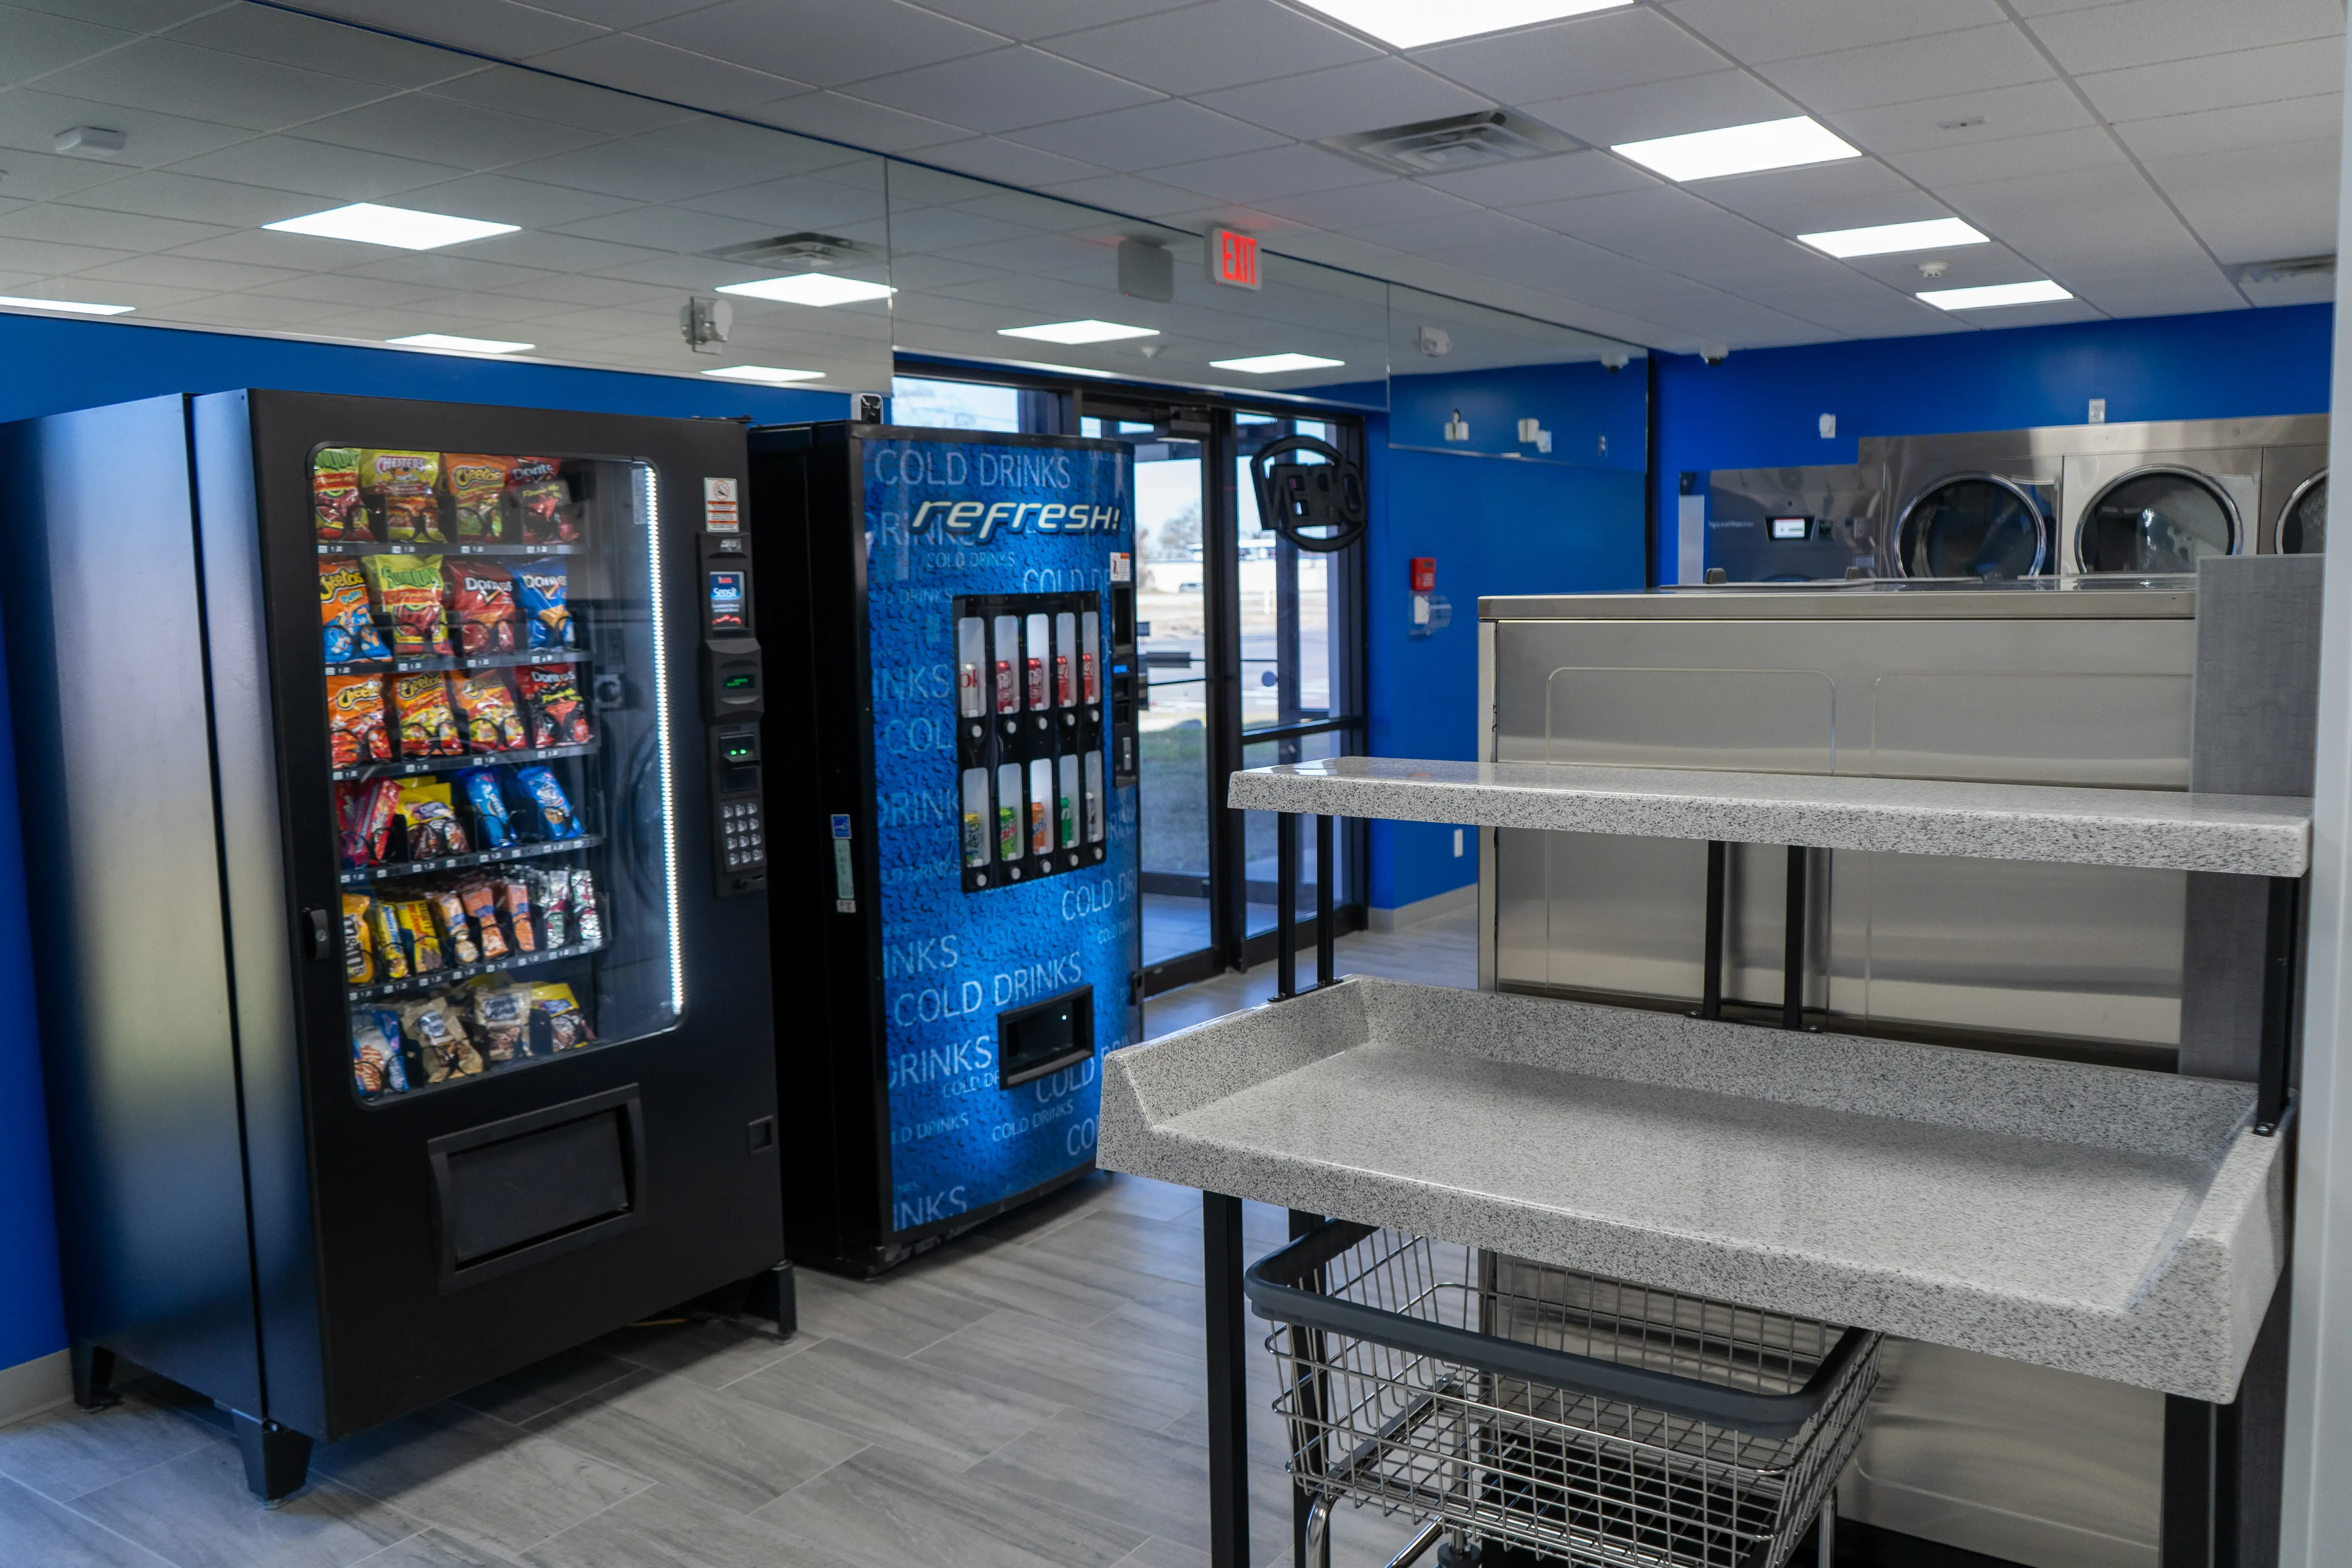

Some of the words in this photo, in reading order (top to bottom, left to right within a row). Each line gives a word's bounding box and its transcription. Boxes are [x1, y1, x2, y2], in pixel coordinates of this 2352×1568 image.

[1222, 230, 1256, 285] EXIT
[874, 449, 967, 486] COLD
[980, 452, 1072, 489] DRINKS
[1062, 879, 1113, 920] COLD
[895, 981, 982, 1027] COLD
[994, 952, 1082, 1006] DRINKS
[942, 1076, 980, 1098] COLD
[917, 1112, 969, 1139] DRINKS
[993, 1118, 1029, 1142] COLD
[1033, 1099, 1074, 1128] DRINKS
